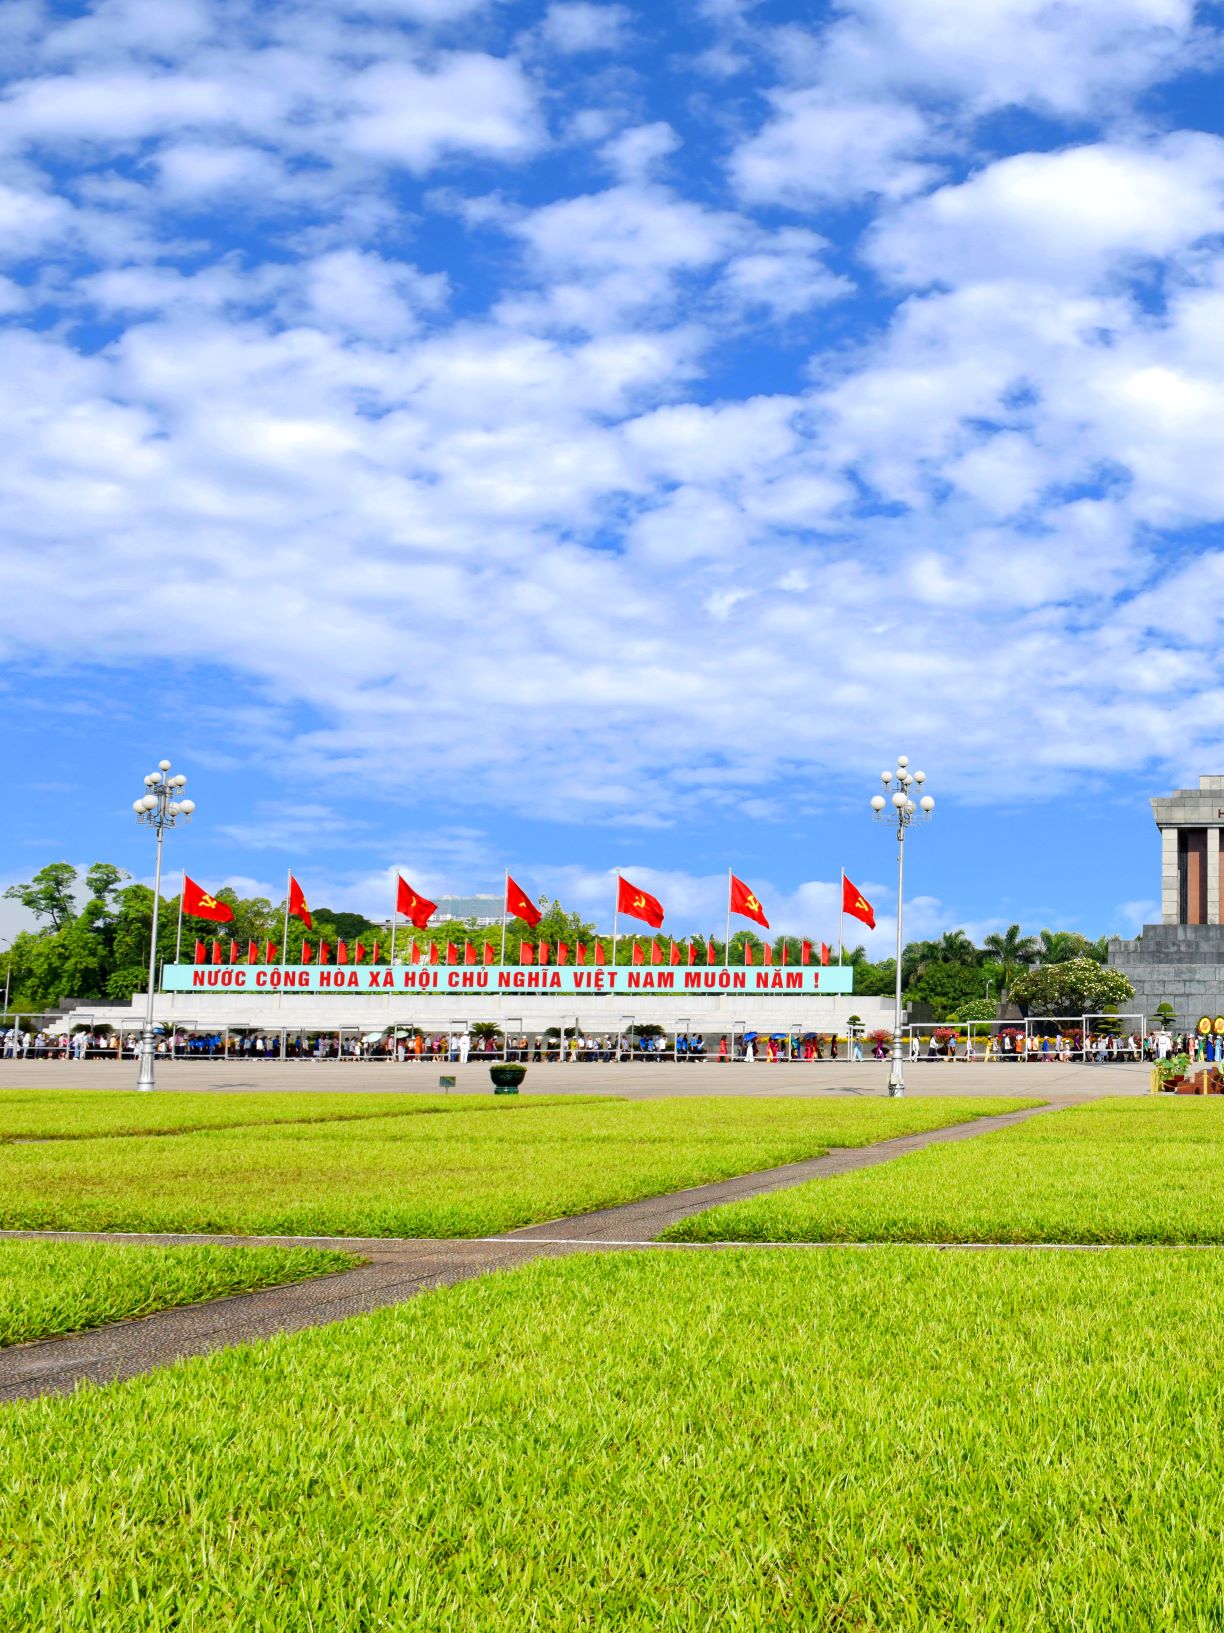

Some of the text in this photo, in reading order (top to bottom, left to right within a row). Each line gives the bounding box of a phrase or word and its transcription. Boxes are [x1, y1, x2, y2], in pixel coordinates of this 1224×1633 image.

[193, 967, 246, 987] NƯỚC
[255, 968, 310, 990] CỘNG
[319, 968, 359, 987] HÒA
[368, 968, 395, 987] XÃ
[404, 968, 438, 990] HỘI
[447, 967, 489, 987] CHỦ
[498, 968, 562, 987] NGHĨA
[573, 968, 618, 991] VIỆT
[627, 972, 675, 988] NAM
[684, 969, 747, 988] MUÔN
[755, 969, 803, 988] NĂM
